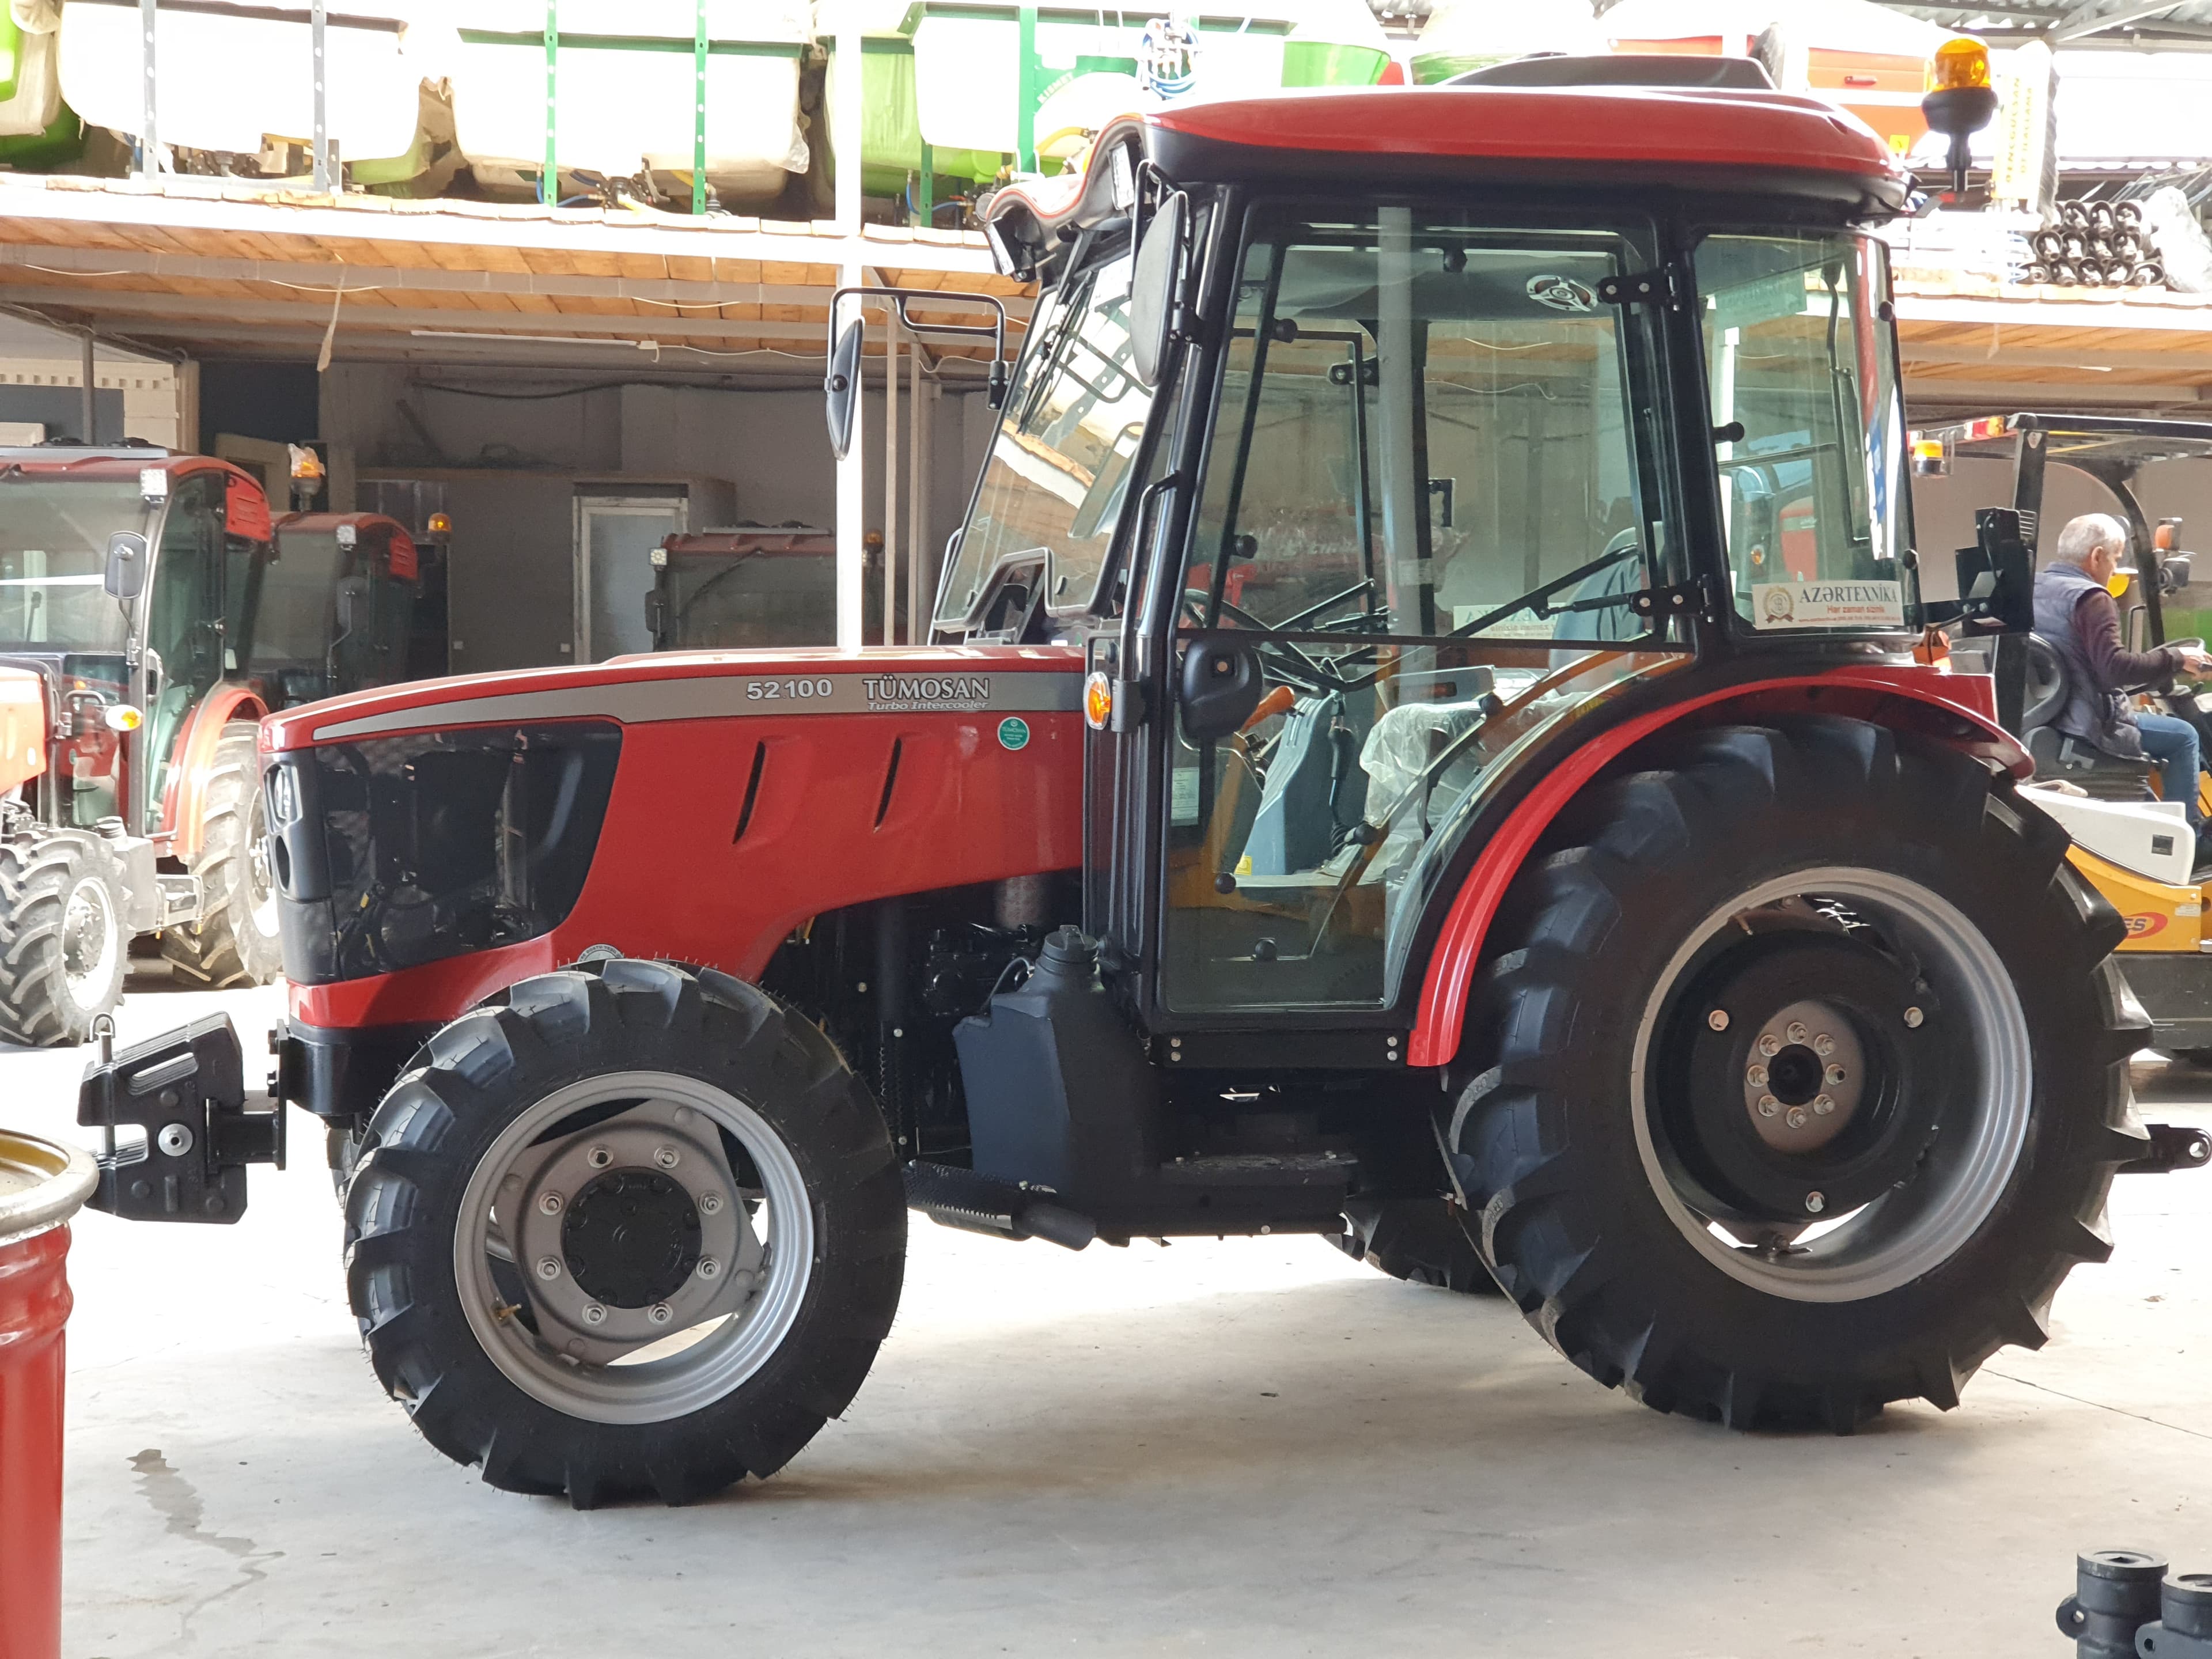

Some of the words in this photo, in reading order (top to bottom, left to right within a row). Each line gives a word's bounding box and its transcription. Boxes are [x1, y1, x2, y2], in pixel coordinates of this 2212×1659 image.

[863, 675, 989, 700] TÜMOSAN
[868, 702, 909, 710] Turbo
[911, 700, 989, 710] Intercooler
